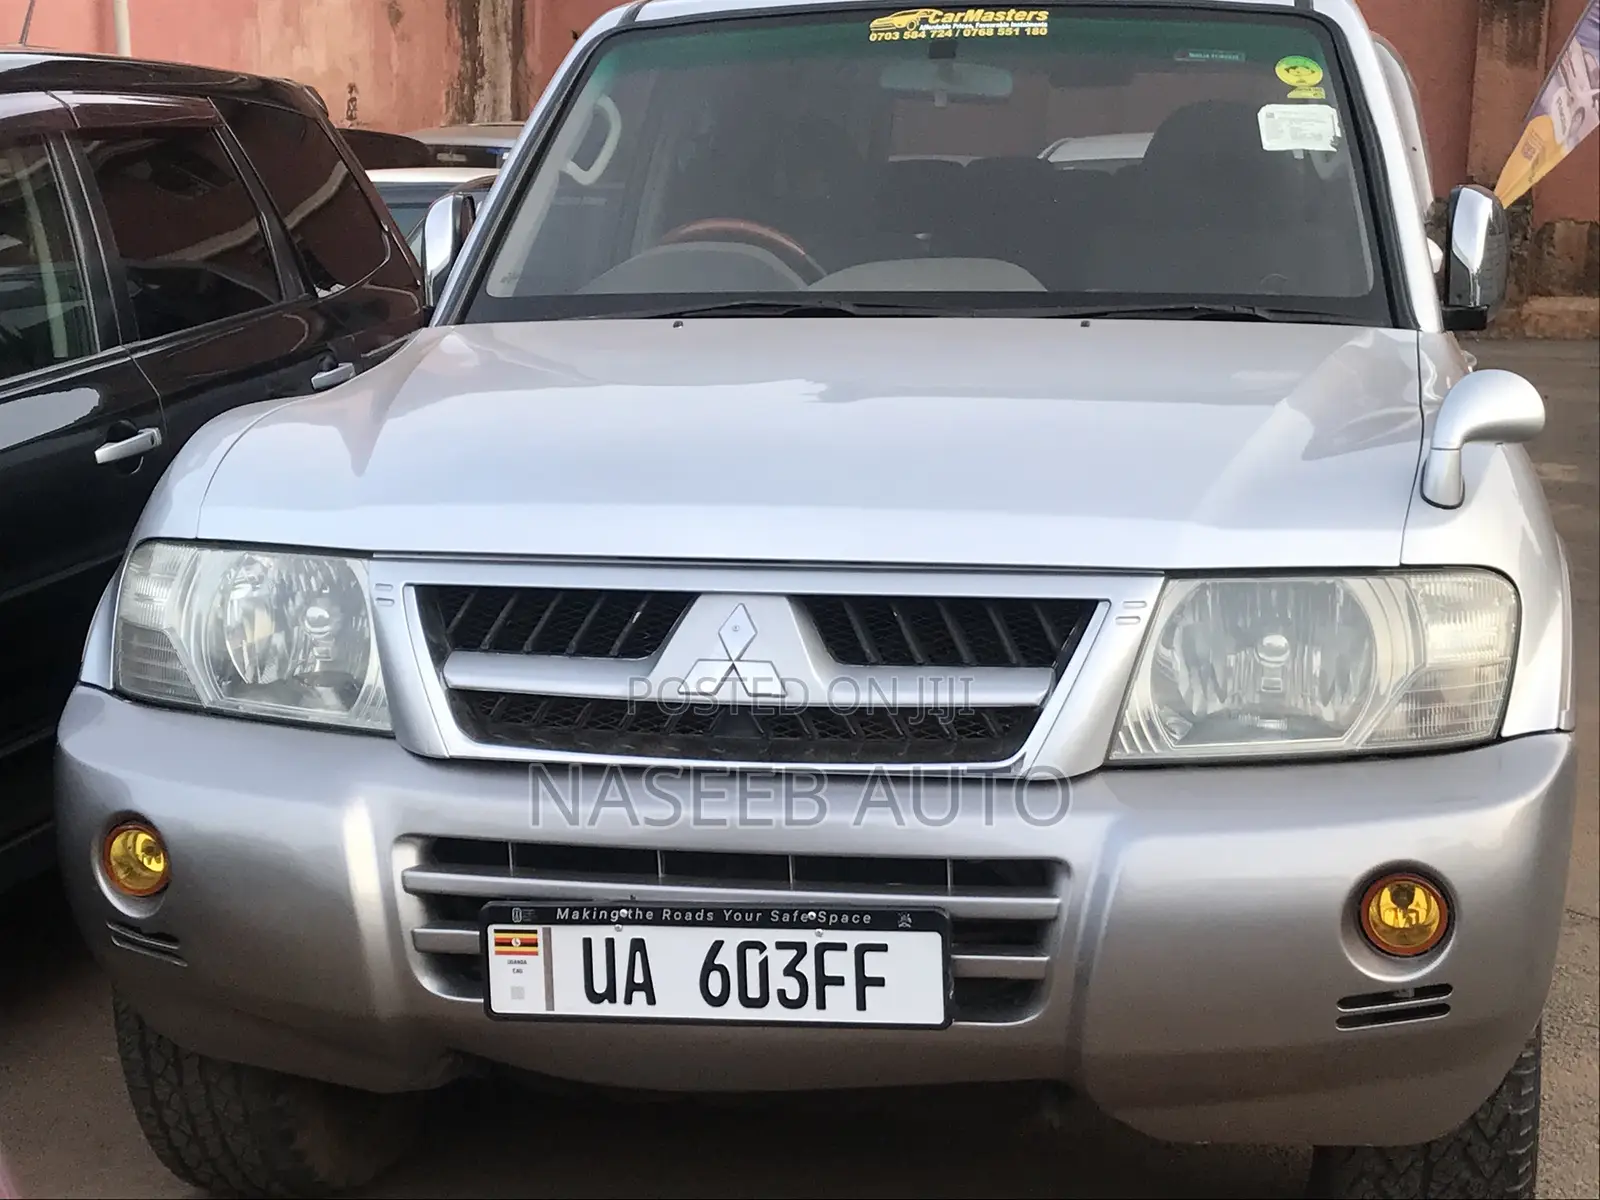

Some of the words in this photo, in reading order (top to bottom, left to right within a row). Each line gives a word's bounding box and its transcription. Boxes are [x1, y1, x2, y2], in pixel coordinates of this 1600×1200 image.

[928, 9, 1049, 24] CarMasters
[869, 32, 900, 42] 0703
[930, 30, 953, 38] 724
[997, 28, 1020, 36] 551
[556, 908, 619, 922] Making
[627, 908, 654, 920] the
[662, 909, 714, 921] Roads
[723, 909, 762, 922] Your
[770, 910, 809, 922] Safe
[818, 911, 872, 925] Space
[582, 936, 657, 1006] UA
[699, 939, 889, 1011] 603FF
